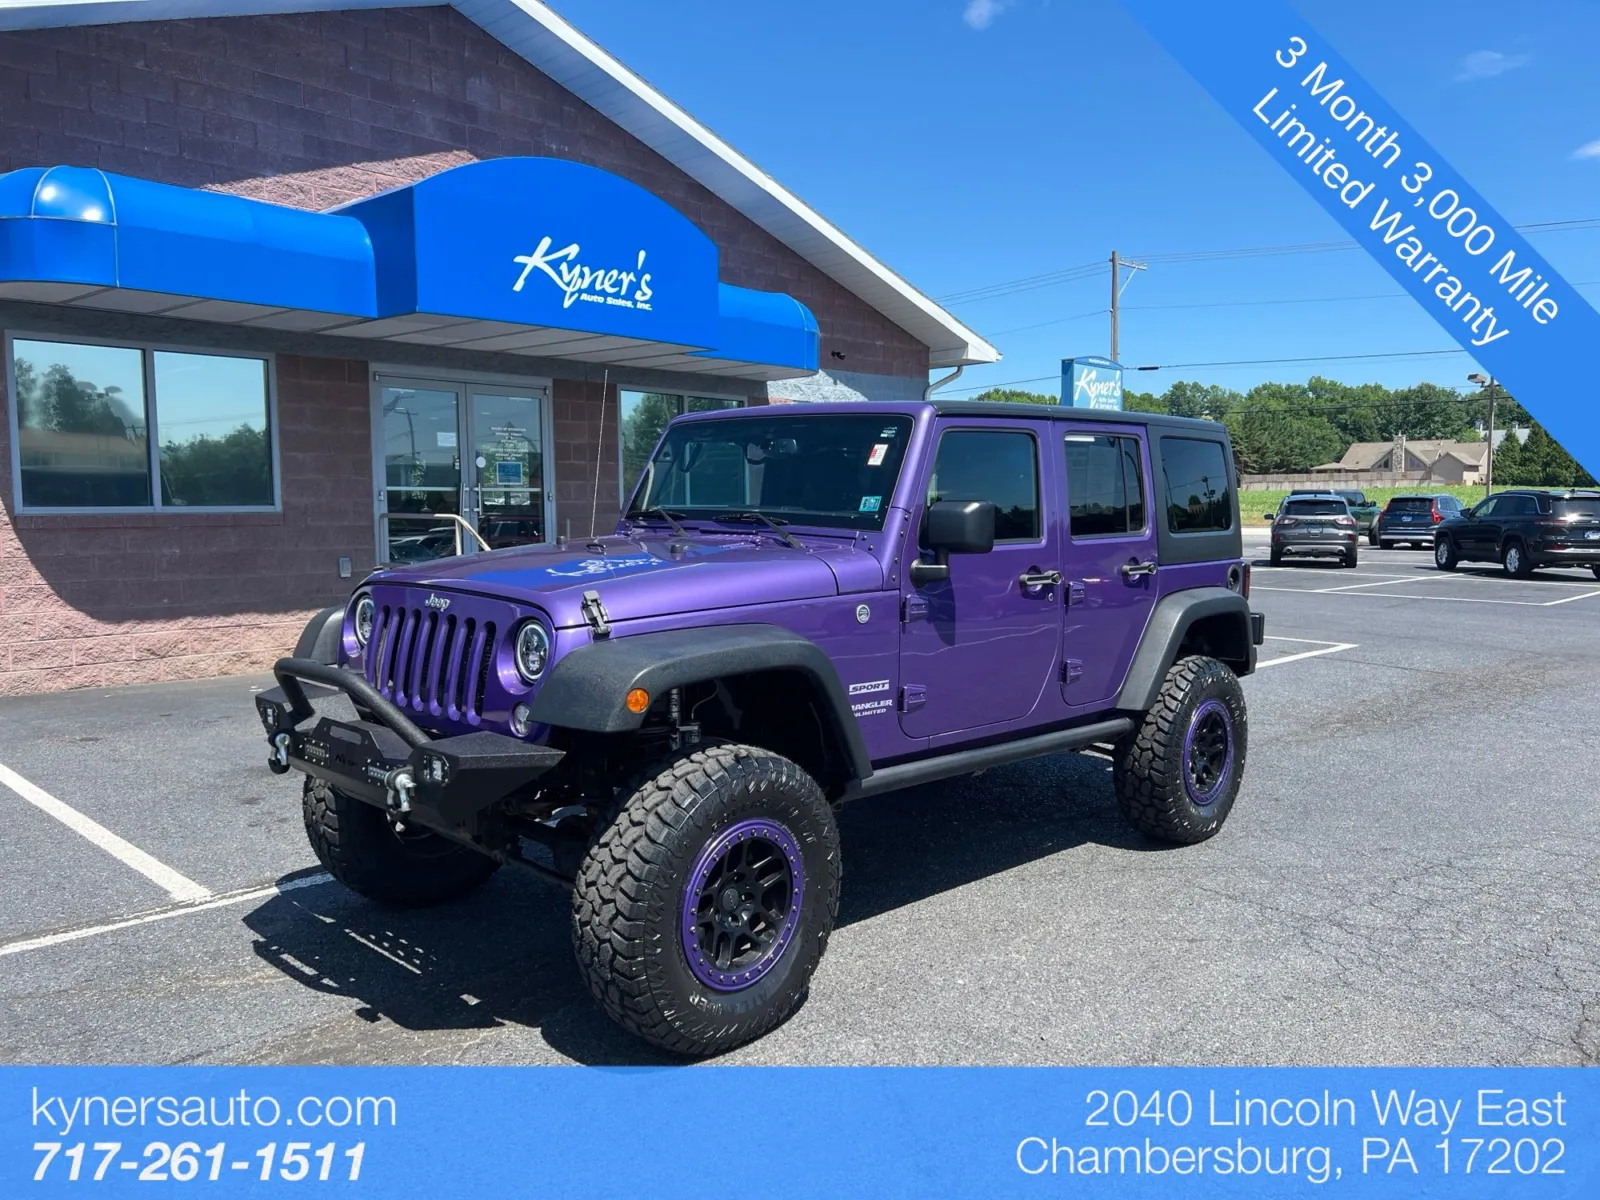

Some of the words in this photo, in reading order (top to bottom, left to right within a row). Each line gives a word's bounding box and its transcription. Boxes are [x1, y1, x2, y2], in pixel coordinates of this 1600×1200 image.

[512, 236, 653, 309] Kyner's
[580, 293, 604, 303] Auto
[606, 296, 634, 308] Sales,
[1074, 368, 1120, 409] Kyner's
[425, 593, 451, 612] Jeep
[851, 682, 888, 693] SPORT
